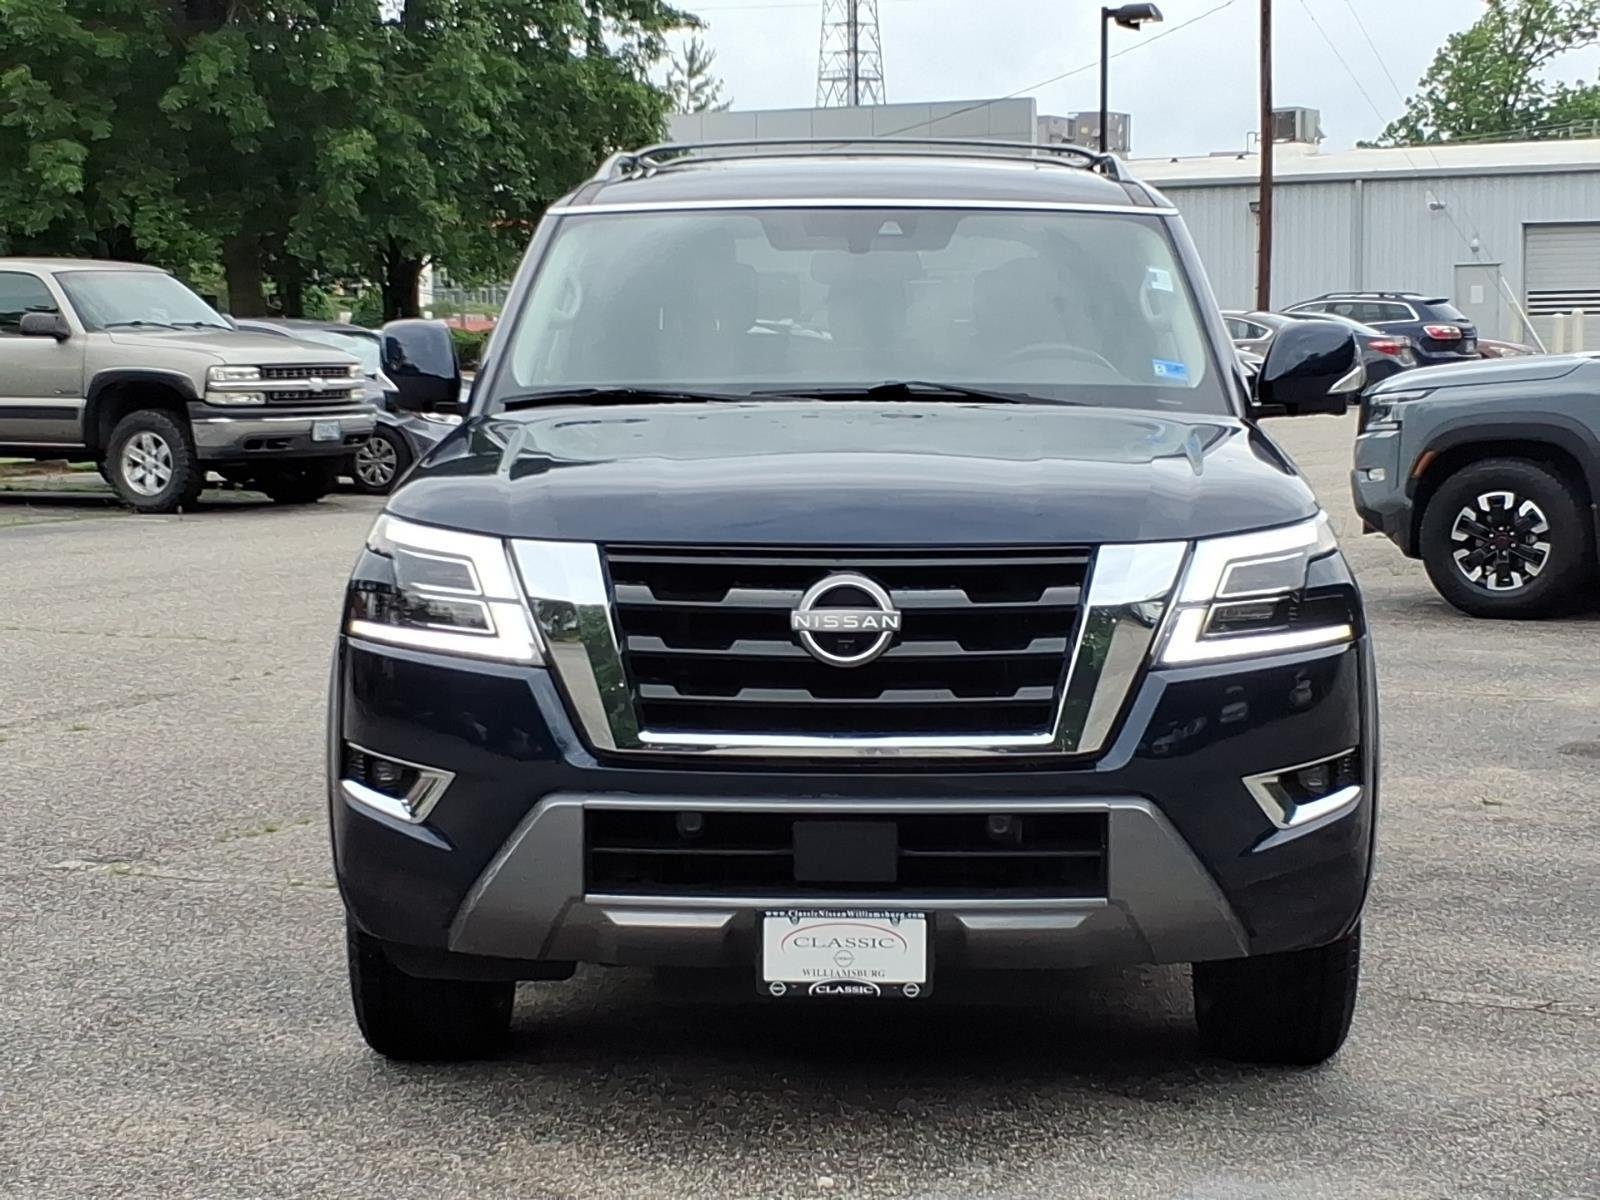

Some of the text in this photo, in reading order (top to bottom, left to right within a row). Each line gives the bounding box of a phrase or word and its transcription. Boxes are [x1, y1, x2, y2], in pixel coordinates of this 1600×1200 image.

[794, 615, 899, 629] NISSAN
[793, 937, 895, 949] CLASSIC
[802, 968, 886, 978] WILLIAMSBURG
[815, 985, 874, 995] CLASSIC
